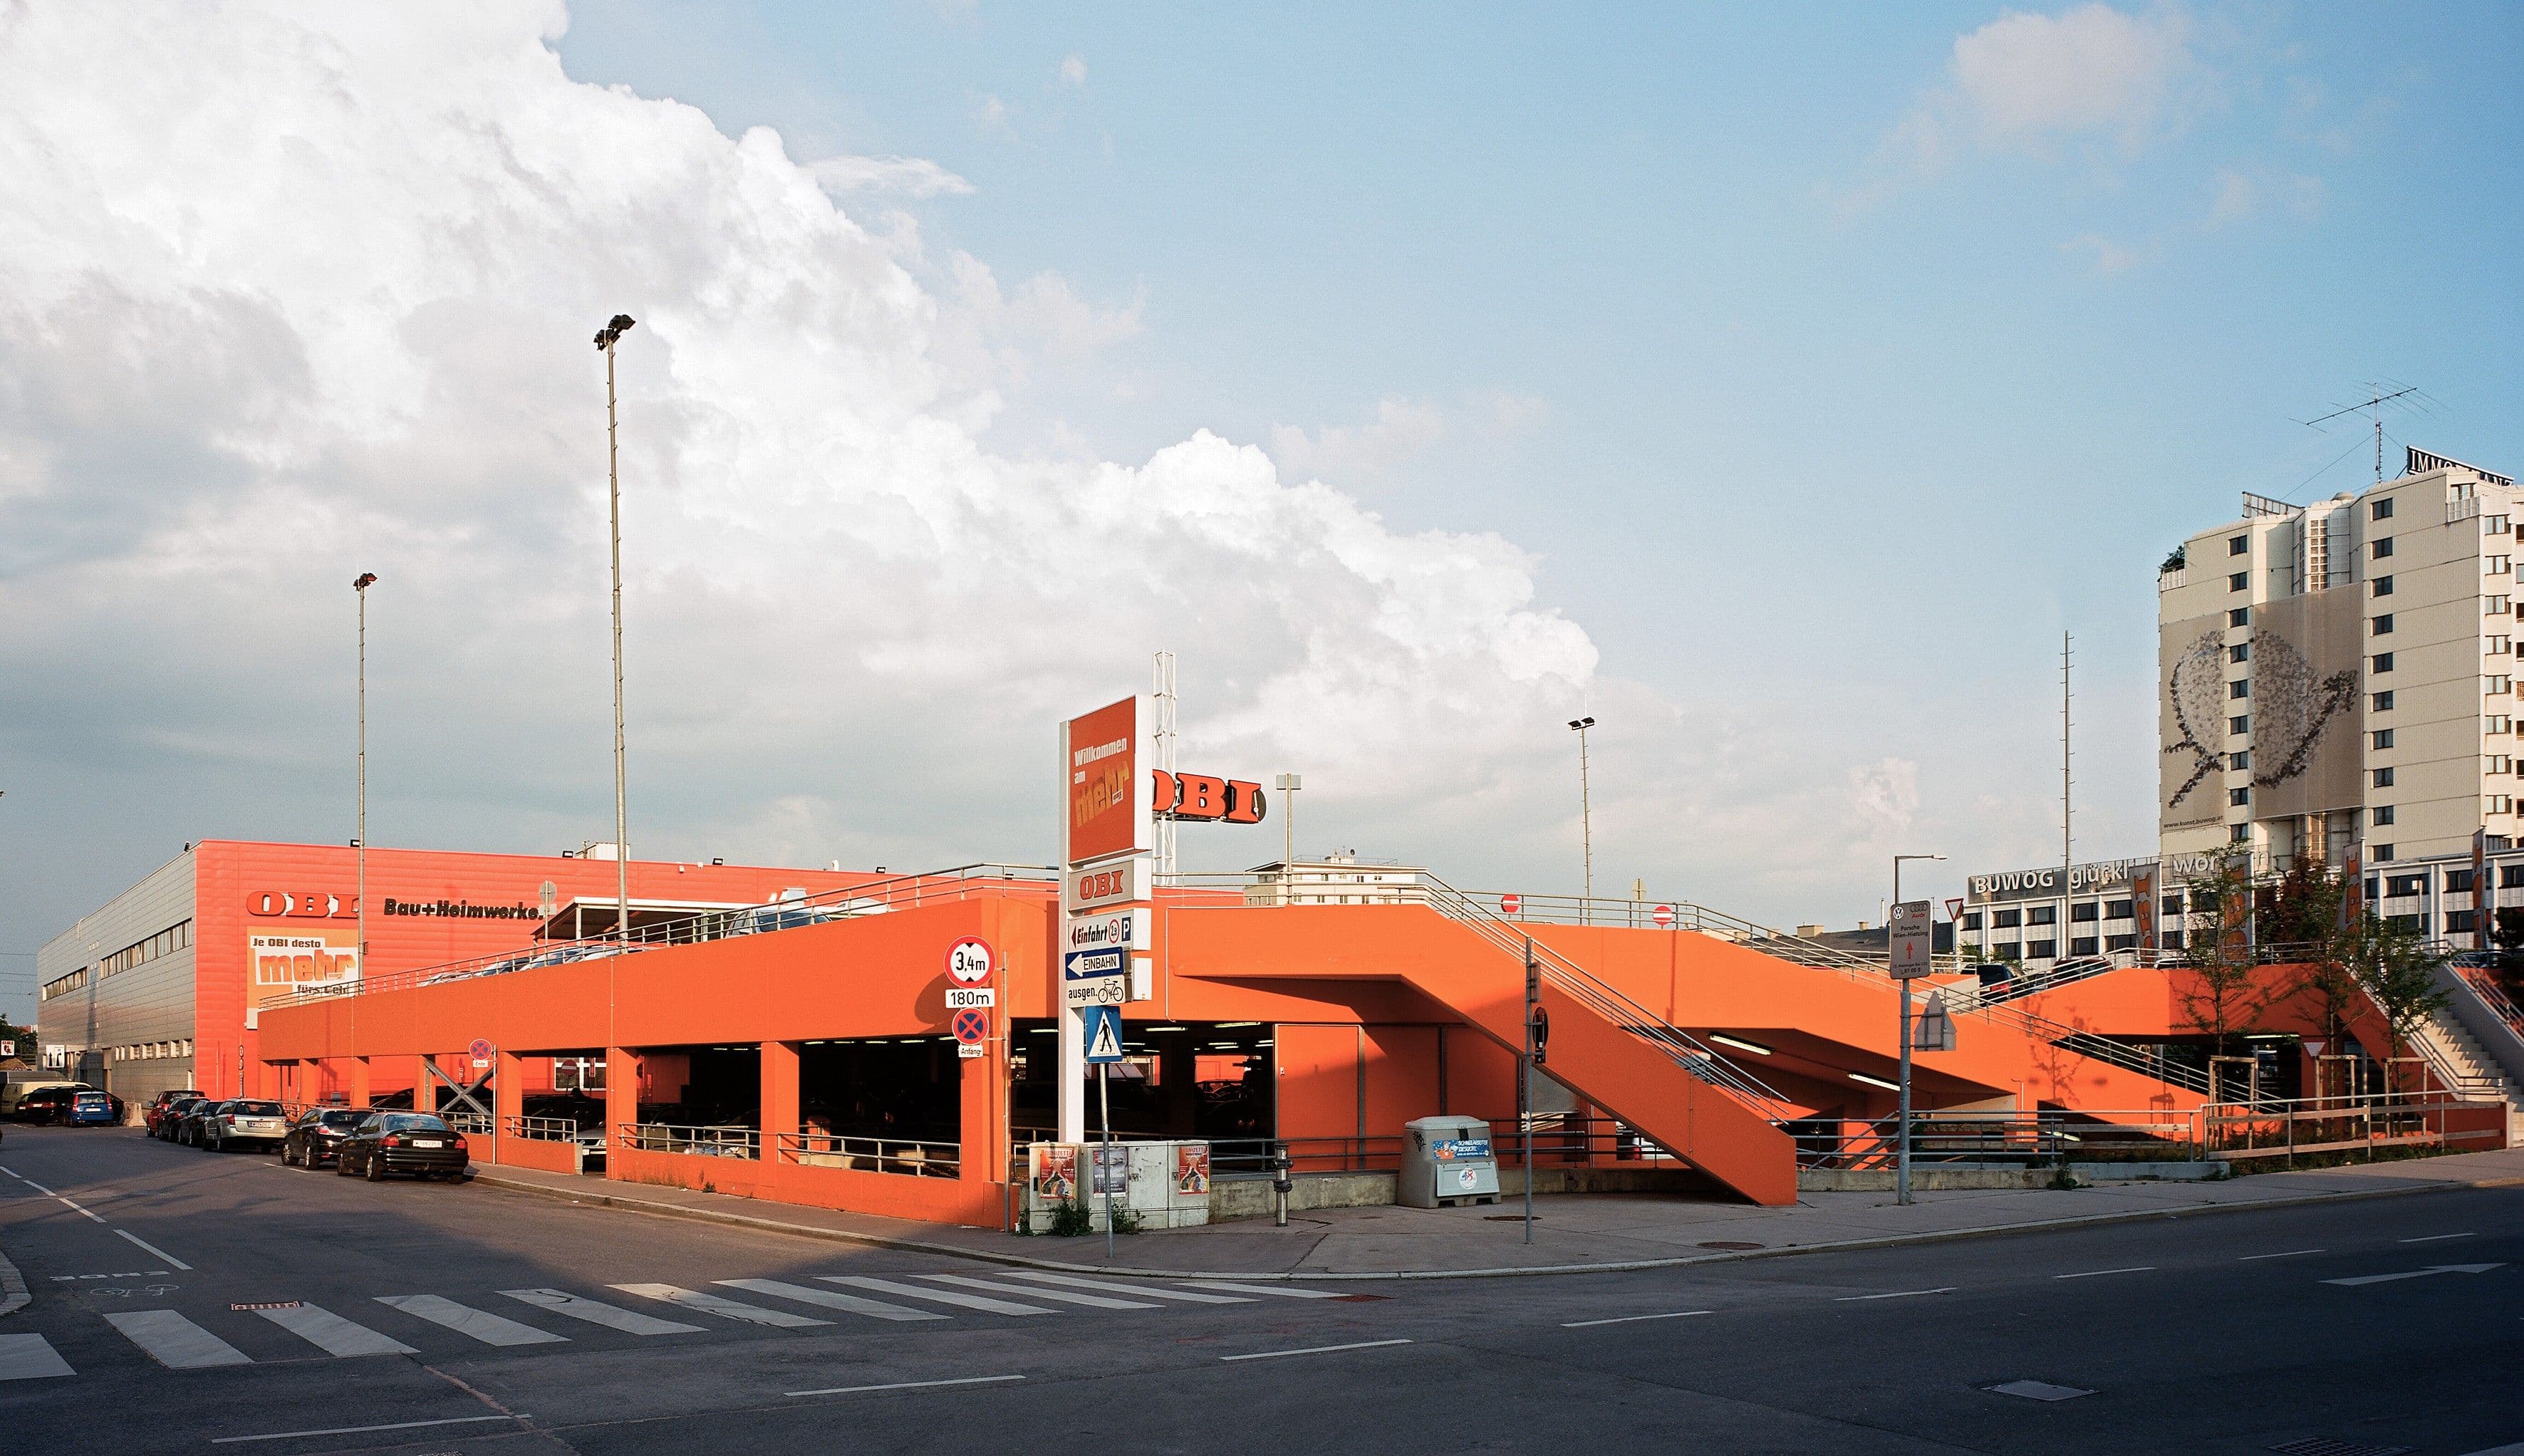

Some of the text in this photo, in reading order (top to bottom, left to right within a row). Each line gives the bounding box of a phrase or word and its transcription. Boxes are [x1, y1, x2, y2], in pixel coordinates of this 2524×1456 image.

[1074, 737, 1128, 767] Willkommen
[1074, 770, 1086, 785] am
[1075, 761, 1130, 828] mehr
[1079, 870, 1124, 900] OBI
[1975, 869, 2055, 894] BUWOG
[2071, 857, 2152, 890] glückl
[246, 890, 360, 919] OBI
[1077, 924, 1108, 945] Einfahrt
[1123, 920, 1130, 939] P
[253, 937, 321, 948] Je OBI desto
[259, 950, 356, 982] mehr
[1084, 956, 1116, 970] EINBAHN
[950, 991, 989, 1005] 180m
[1069, 987, 1098, 1001] ausgen.
[1462, 1170, 1473, 1181] 48
